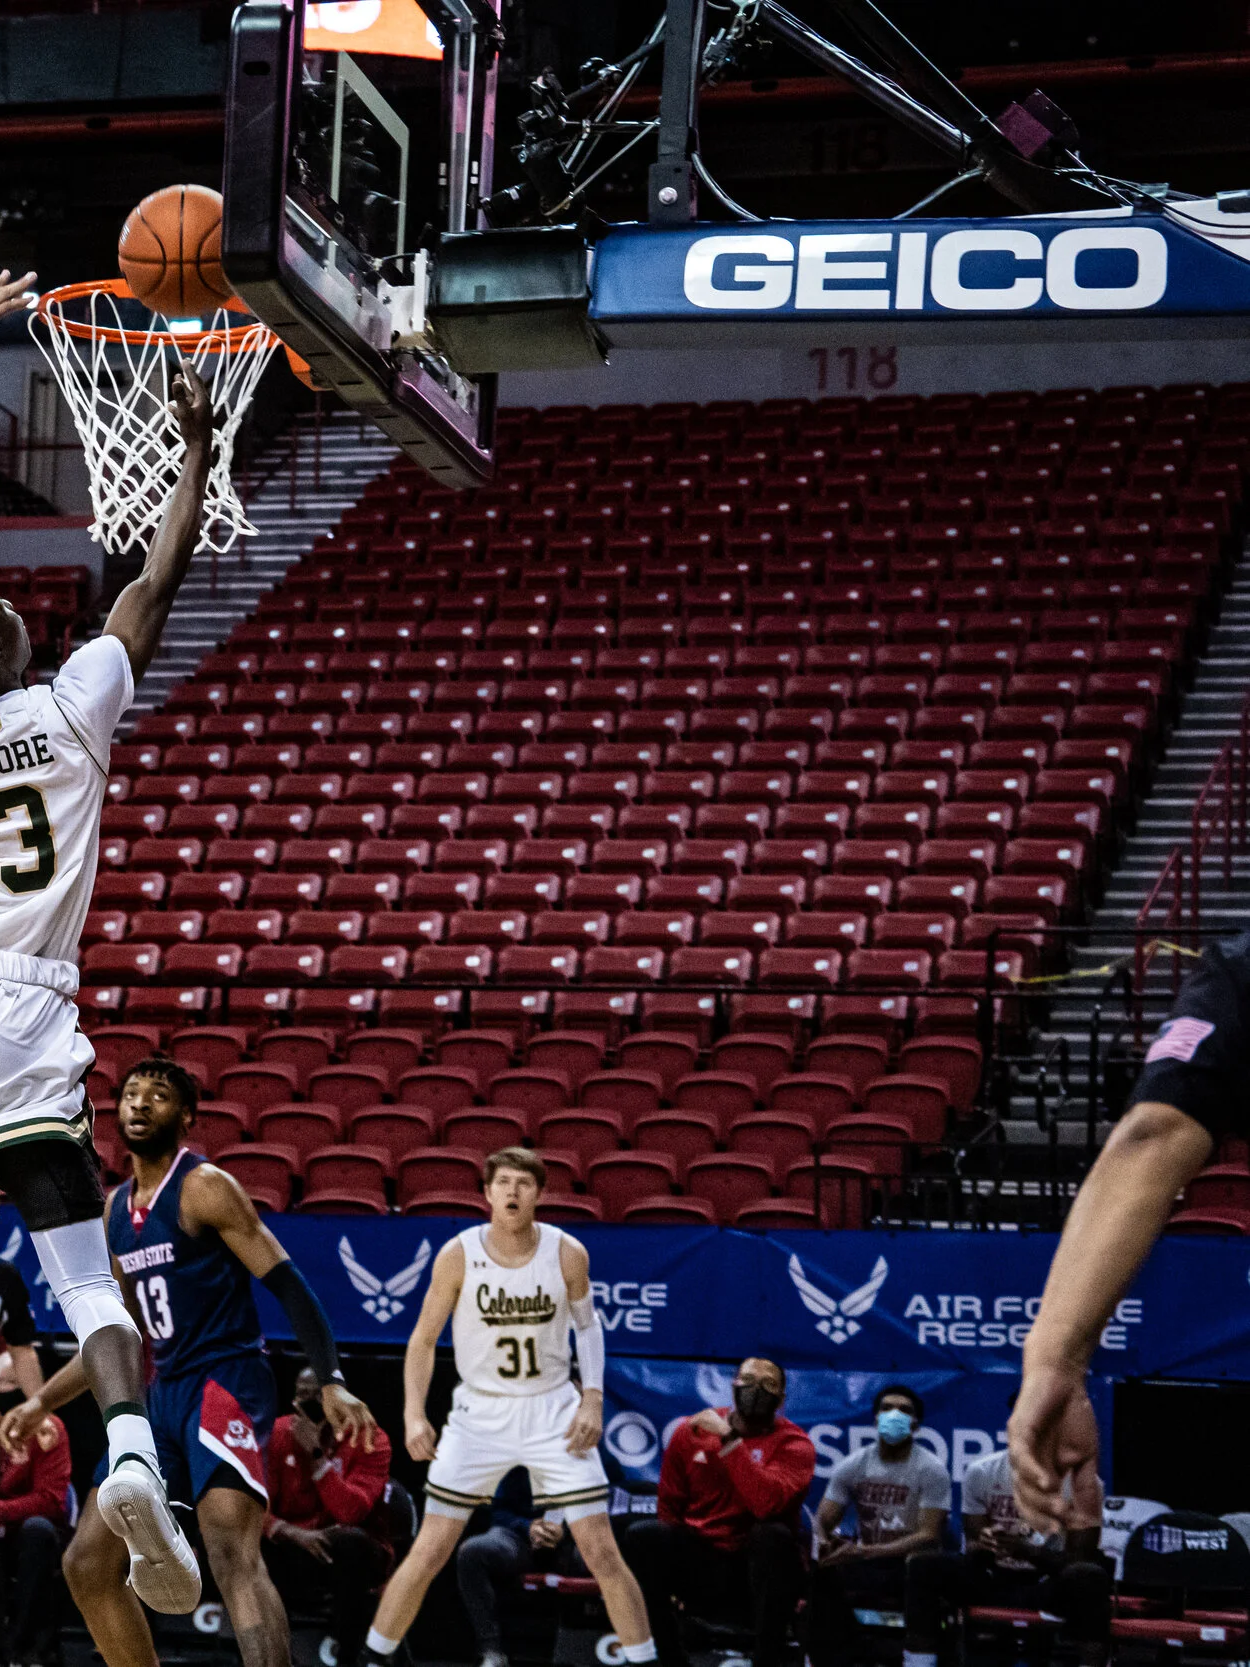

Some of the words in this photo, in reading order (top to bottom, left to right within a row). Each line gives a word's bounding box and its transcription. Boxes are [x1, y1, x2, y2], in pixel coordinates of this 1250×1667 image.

[683, 227, 1169, 310] GEICO
[808, 346, 897, 390] 118
[135, 1275, 175, 1340] 13
[477, 1283, 557, 1316] Colorado
[590, 1280, 668, 1307] RCE
[903, 1293, 983, 1320] AIR
[993, 1296, 1143, 1324] FOE
[917, 1320, 1128, 1350] RESEE
[496, 1337, 541, 1378] 31
[1185, 1538, 1228, 1551] WEST
